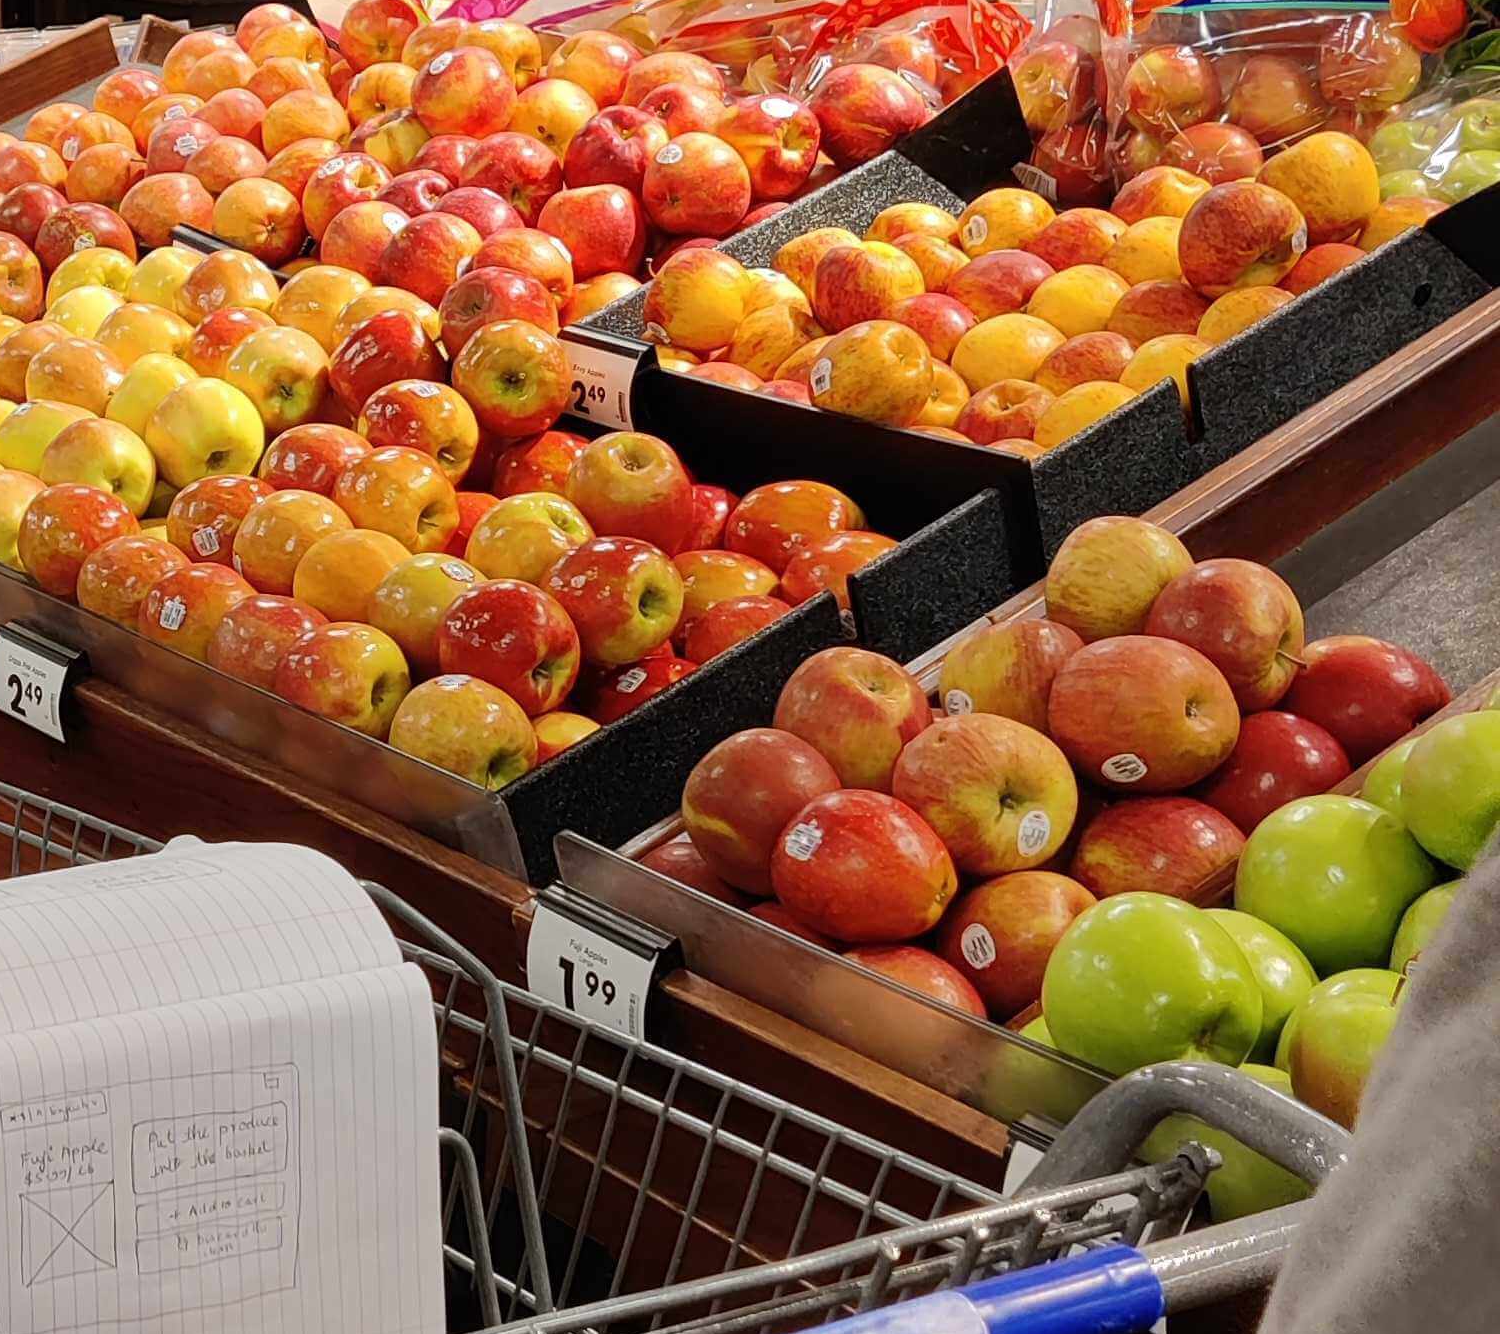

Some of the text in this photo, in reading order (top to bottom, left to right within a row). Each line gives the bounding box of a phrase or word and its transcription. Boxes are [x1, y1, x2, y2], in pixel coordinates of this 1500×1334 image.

[583, 948, 608, 966] Apples
[148, 1112, 280, 1151] Put the produce
[19, 1137, 110, 1175] Fuji Apple
[150, 1140, 274, 1180] into the basket
